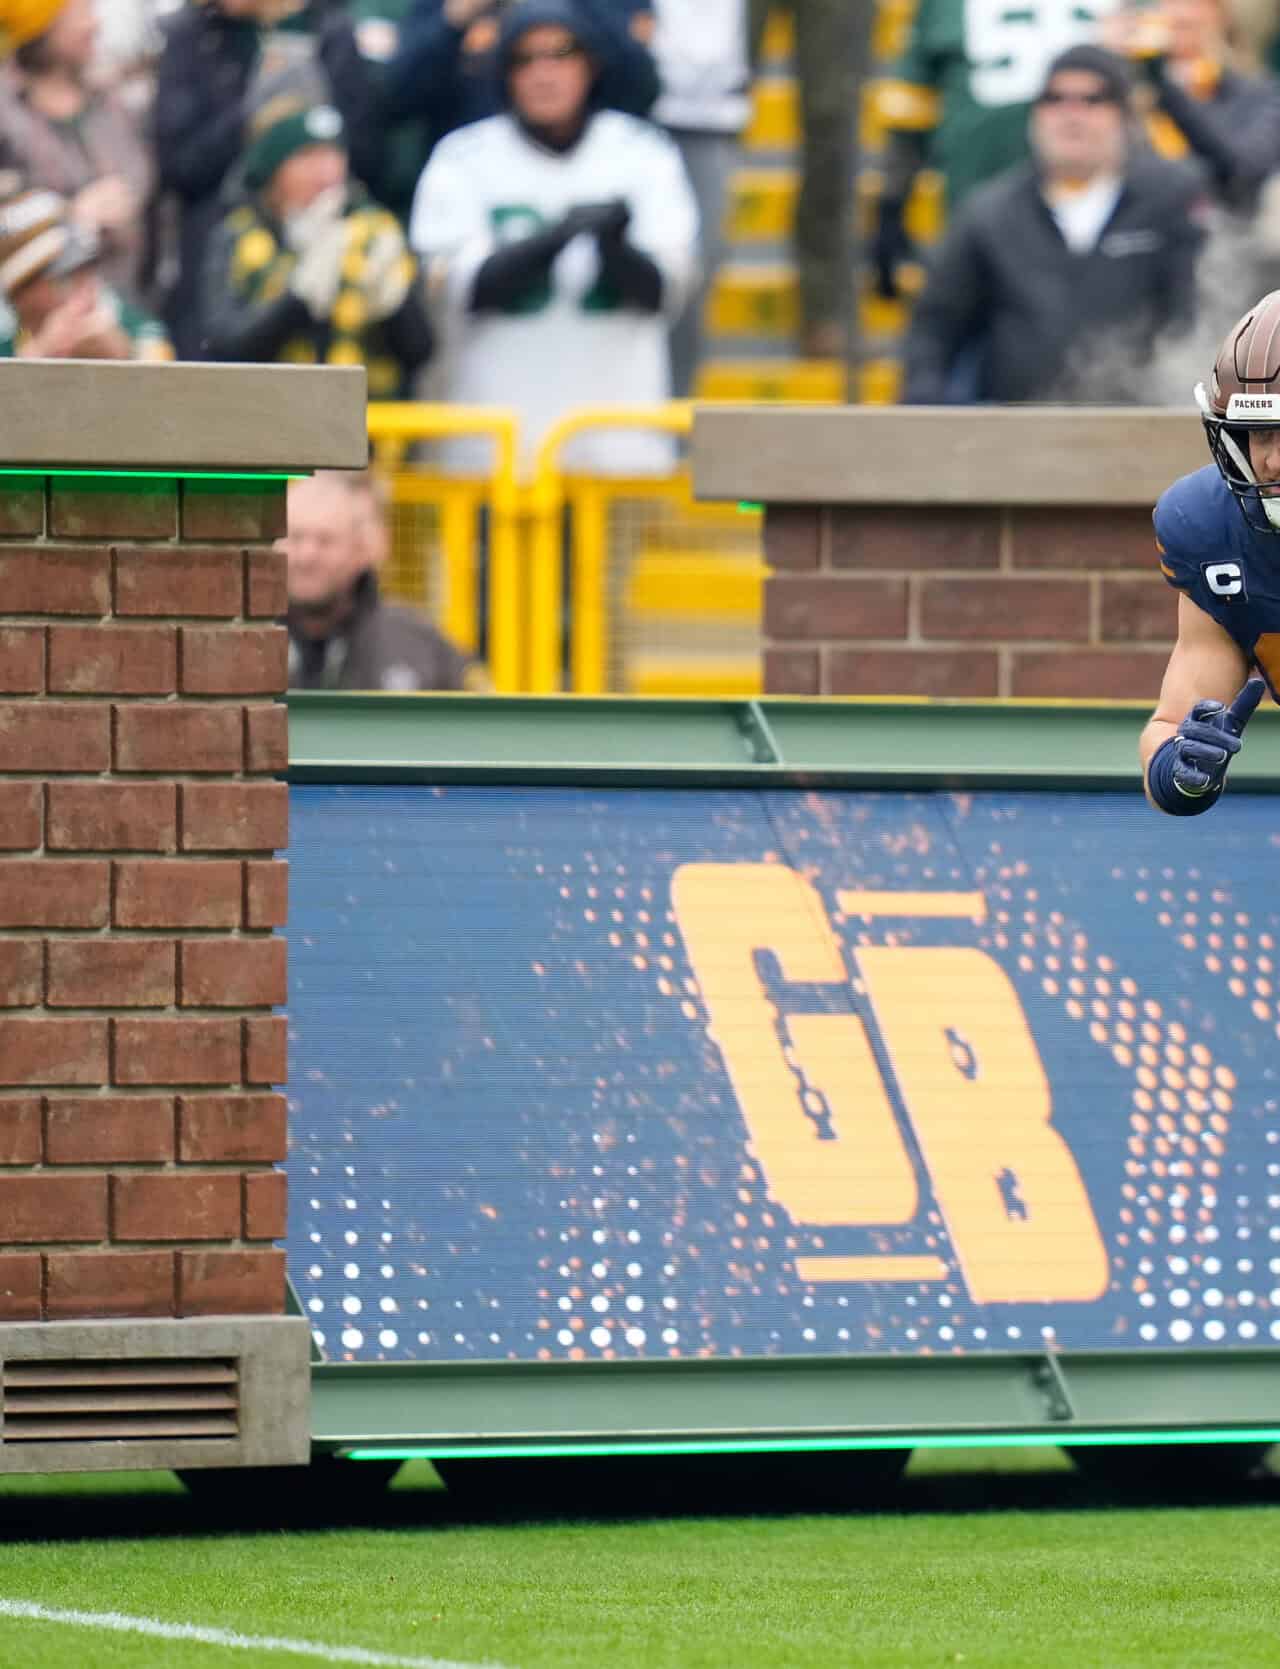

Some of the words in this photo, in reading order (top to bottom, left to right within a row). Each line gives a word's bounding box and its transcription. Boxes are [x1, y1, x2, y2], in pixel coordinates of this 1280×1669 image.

[1234, 399, 1273, 409] PACKERS
[1205, 563, 1242, 595] C
[671, 862, 1109, 1302] GB
